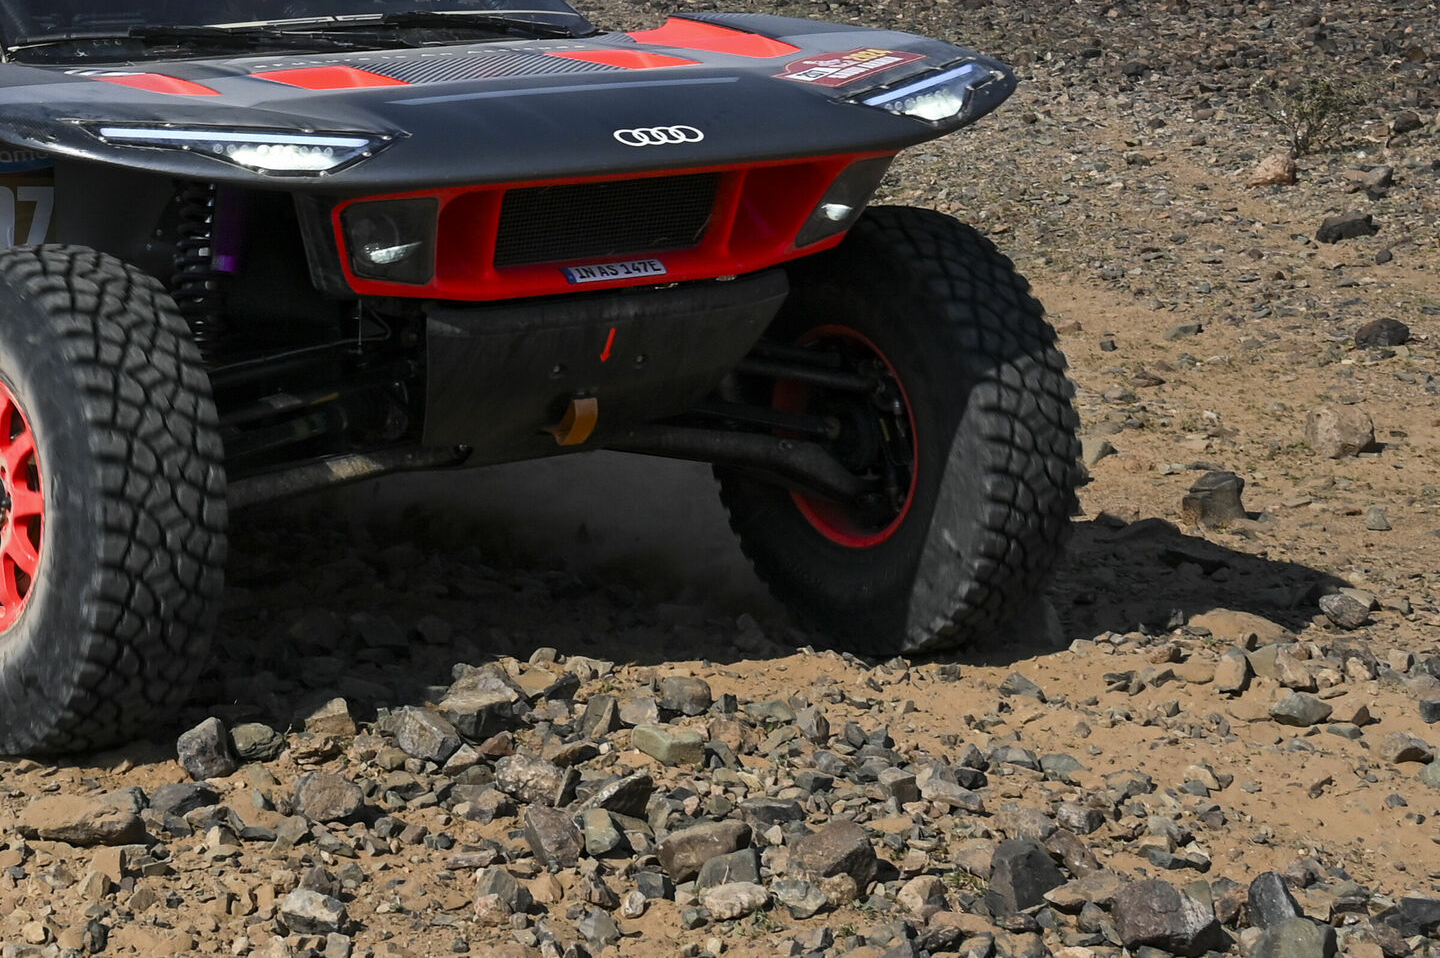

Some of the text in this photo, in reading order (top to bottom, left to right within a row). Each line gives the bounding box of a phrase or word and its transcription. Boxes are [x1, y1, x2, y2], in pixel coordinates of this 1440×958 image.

[575, 260, 662, 279] IN AS 147E
